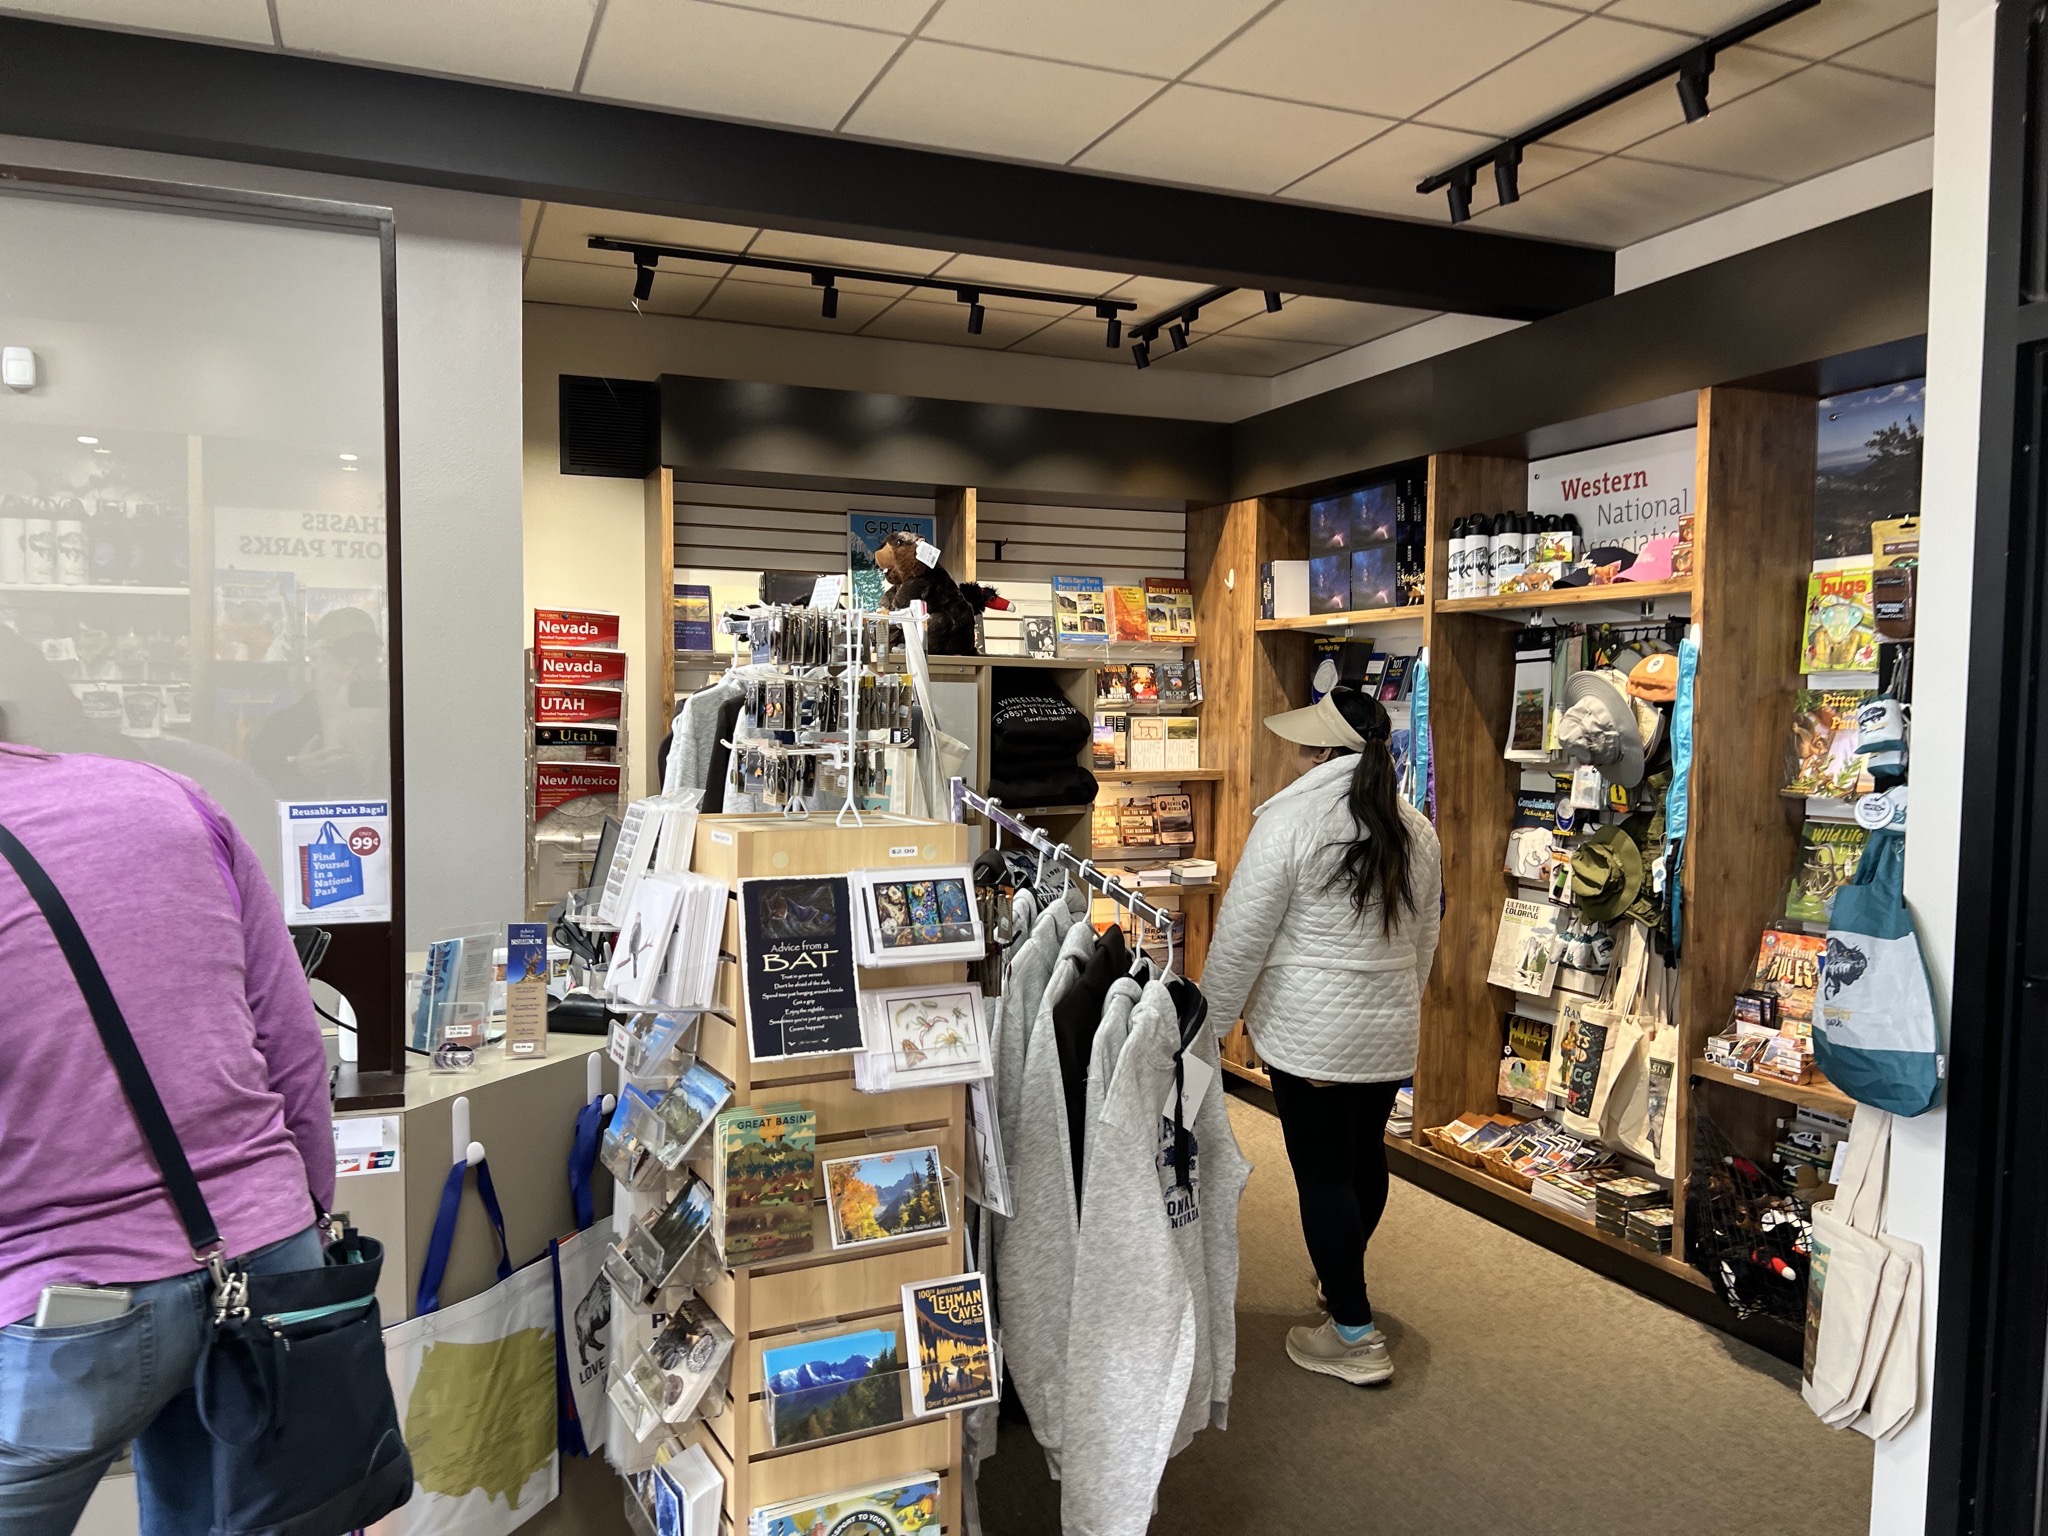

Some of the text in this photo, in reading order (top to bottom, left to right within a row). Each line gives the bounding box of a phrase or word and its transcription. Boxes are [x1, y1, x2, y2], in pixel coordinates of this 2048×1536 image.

[1561, 470, 1648, 501] Western
[1598, 488, 1688, 526] National
[864, 521, 921, 534] GREAT
[1148, 586, 1170, 594] DESERT
[1821, 577, 1866, 599] bugs
[539, 620, 598, 635] Nevada
[543, 659, 602, 673] Nevada
[1392, 660, 1402, 669] 101
[541, 697, 585, 710] UTAH
[998, 697, 1042, 707] WHEELER
[1821, 693, 1859, 707] Pitter
[1029, 707, 1038, 715] N
[560, 730, 597, 741] Utah
[540, 775, 617, 786] New Mexico
[292, 806, 384, 816] Reusable Park Bags!
[1812, 828, 1863, 842] Wild Life
[352, 836, 380, 850] 99¢
[312, 852, 336, 861] Find
[313, 860, 350, 870] Yourself
[314, 871, 325, 879] in
[314, 875, 353, 888] National
[315, 887, 337, 897] Park
[1507, 901, 1540, 912] ULTIMATE
[1505, 907, 1539, 920] COLORING
[770, 942, 800, 953] Advice
[801, 940, 822, 951] from
[762, 949, 839, 972] BAT
[1767, 956, 1813, 989] RULES
[774, 982, 787, 990] Don't
[762, 992, 778, 1000] Spend
[787, 991, 796, 999] just
[785, 1008, 800, 1016] Enjoy
[1510, 1015, 1550, 1041] CAVES
[737, 1115, 807, 1130] GREAT BASIN
[1171, 1207, 1199, 1229] NEVADA
[936, 1285, 965, 1295] ANNIVERSARY
[929, 1289, 981, 1314] LEHMAN
[948, 1303, 983, 1324] CAVES
[579, 1356, 606, 1385] LOVE
[869, 1513, 887, 1528] YOUR
